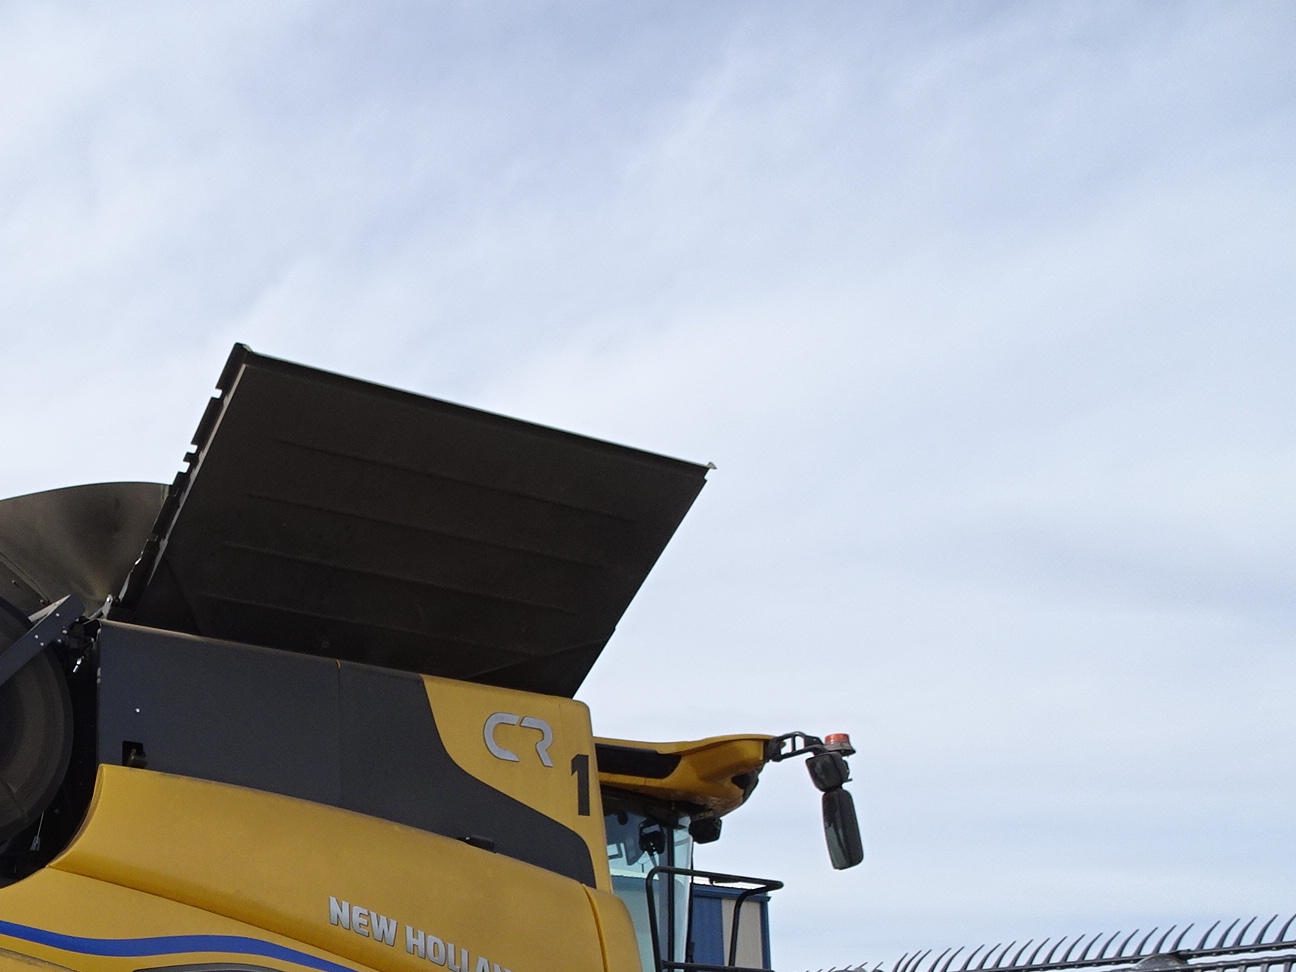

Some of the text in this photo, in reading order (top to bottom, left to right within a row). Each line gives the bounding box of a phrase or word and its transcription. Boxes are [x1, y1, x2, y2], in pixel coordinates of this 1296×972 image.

[483, 711, 553, 767] CR
[570, 753, 590, 816] 1
[329, 896, 398, 937] NEW
